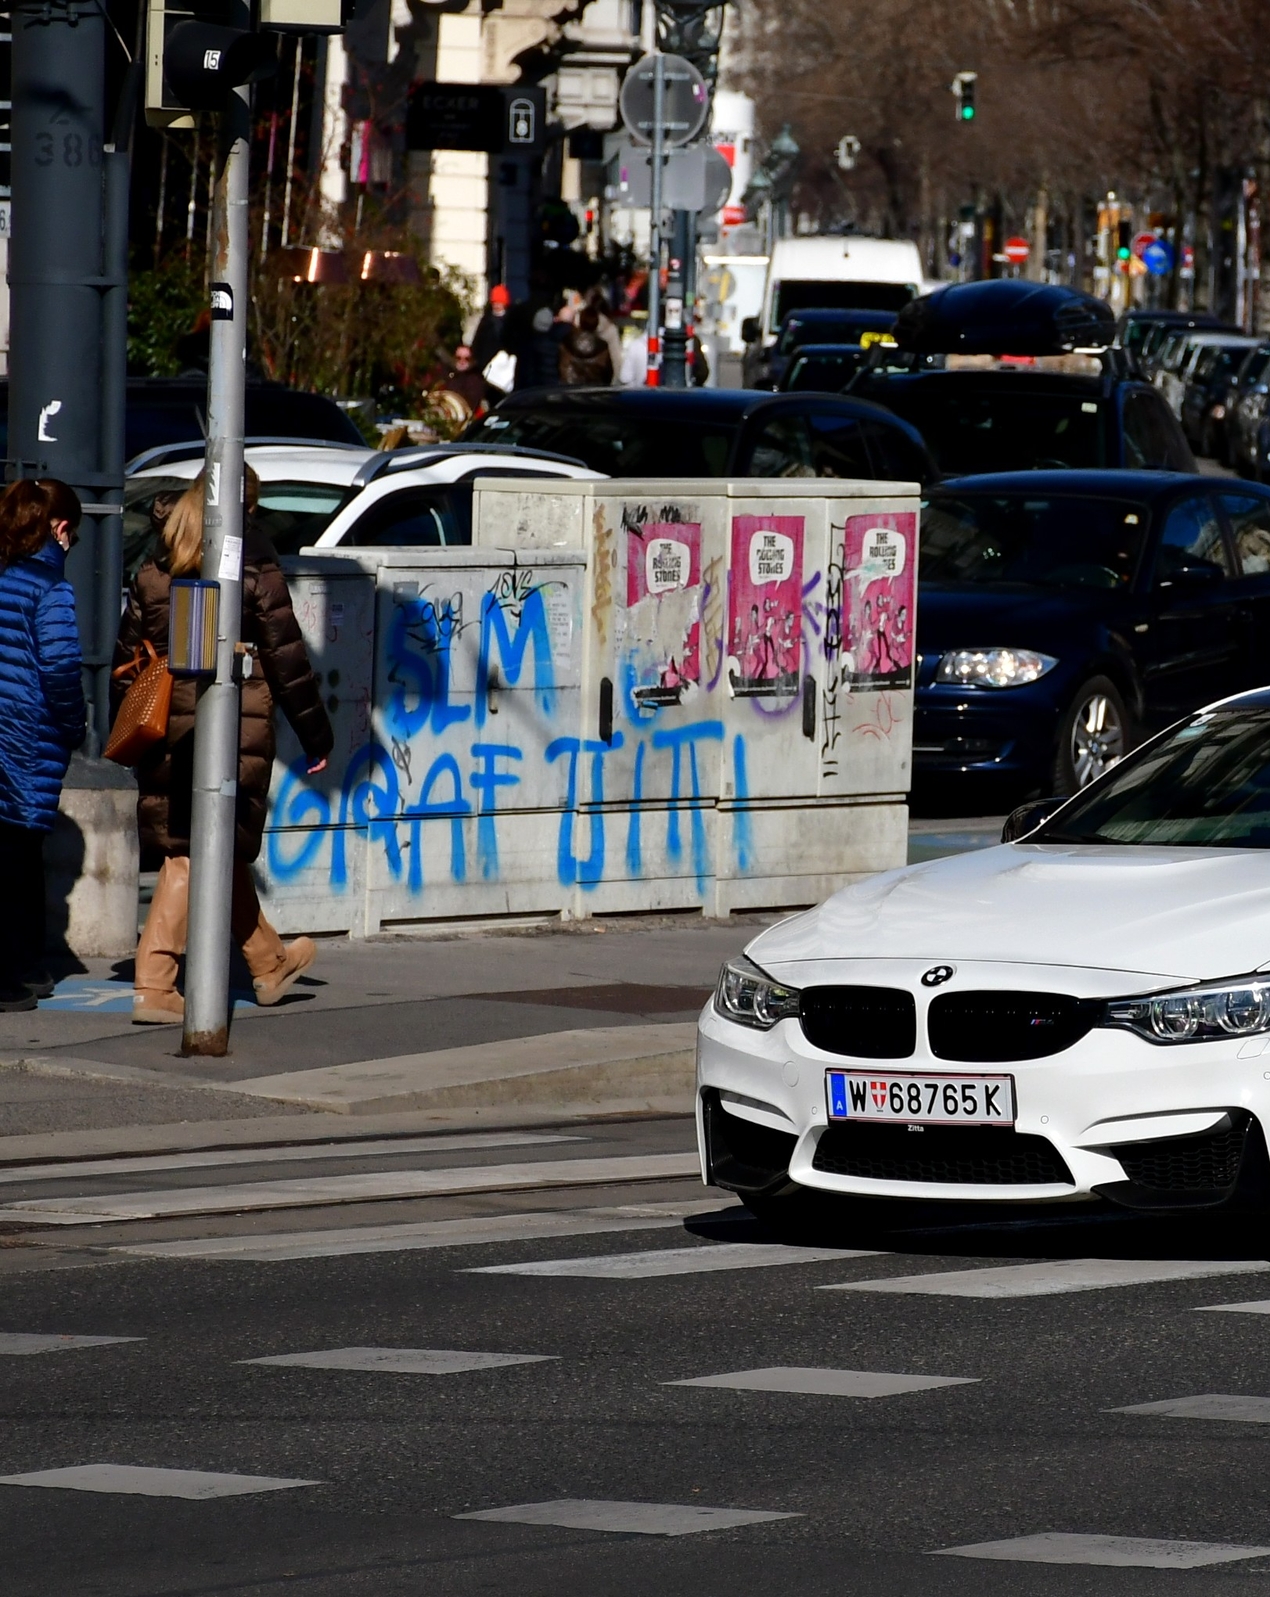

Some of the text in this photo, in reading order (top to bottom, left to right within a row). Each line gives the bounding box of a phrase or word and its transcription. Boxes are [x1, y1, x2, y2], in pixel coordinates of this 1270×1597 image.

[205, 51, 219, 69] 15
[763, 535, 776, 547] THE
[876, 532, 888, 545] THE
[849, 1080, 867, 1112] W
[836, 1102, 843, 1110] A
[907, 1124, 925, 1132] Zitta
